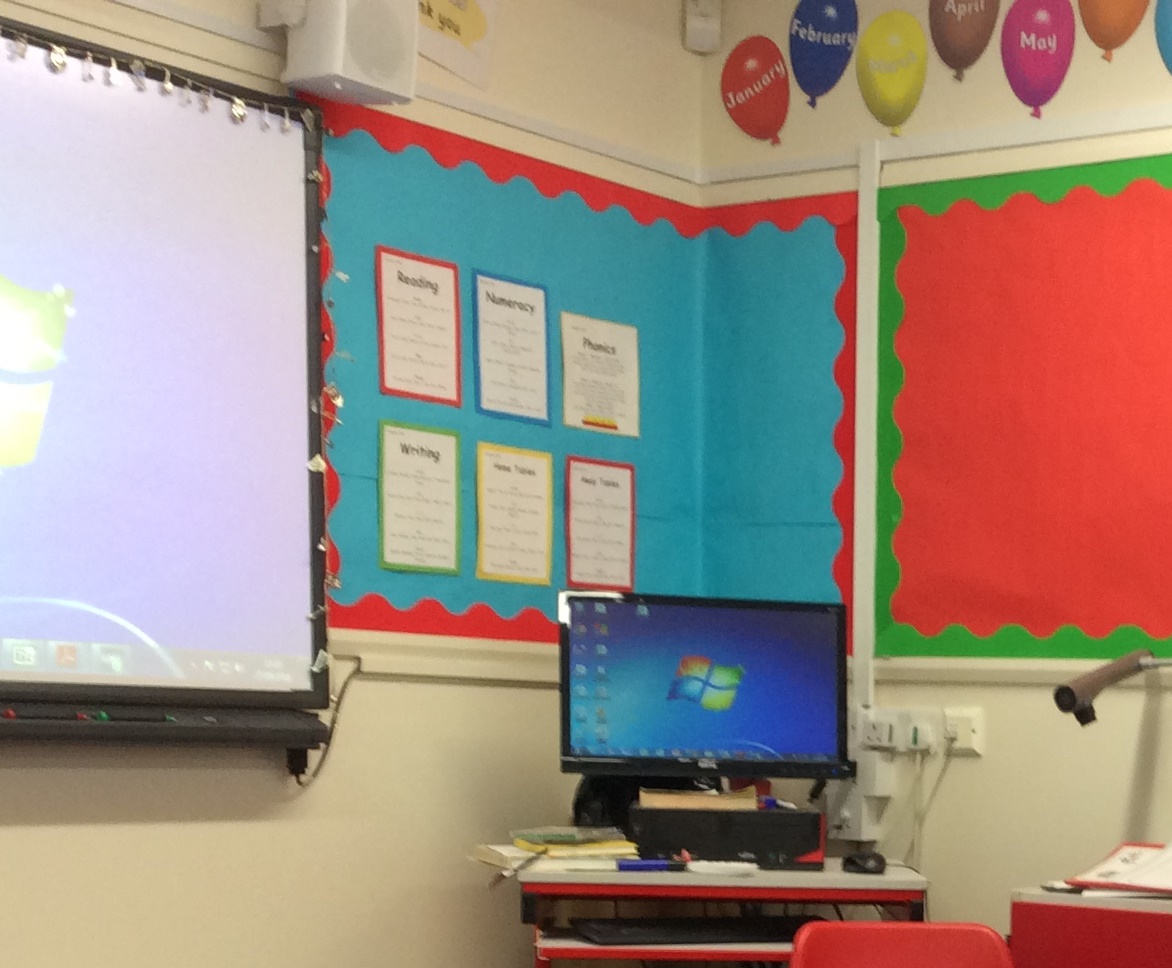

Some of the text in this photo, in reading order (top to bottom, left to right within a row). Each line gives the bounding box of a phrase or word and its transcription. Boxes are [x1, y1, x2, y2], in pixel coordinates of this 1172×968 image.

[943, 0, 985, 22] April
[790, 18, 857, 51] February
[1020, 31, 1057, 54] May
[726, 58, 787, 109] January
[396, 269, 439, 296] Reading
[485, 289, 535, 317] Numeracy
[582, 336, 617, 356] Phonics
[399, 440, 442, 464] Writing
